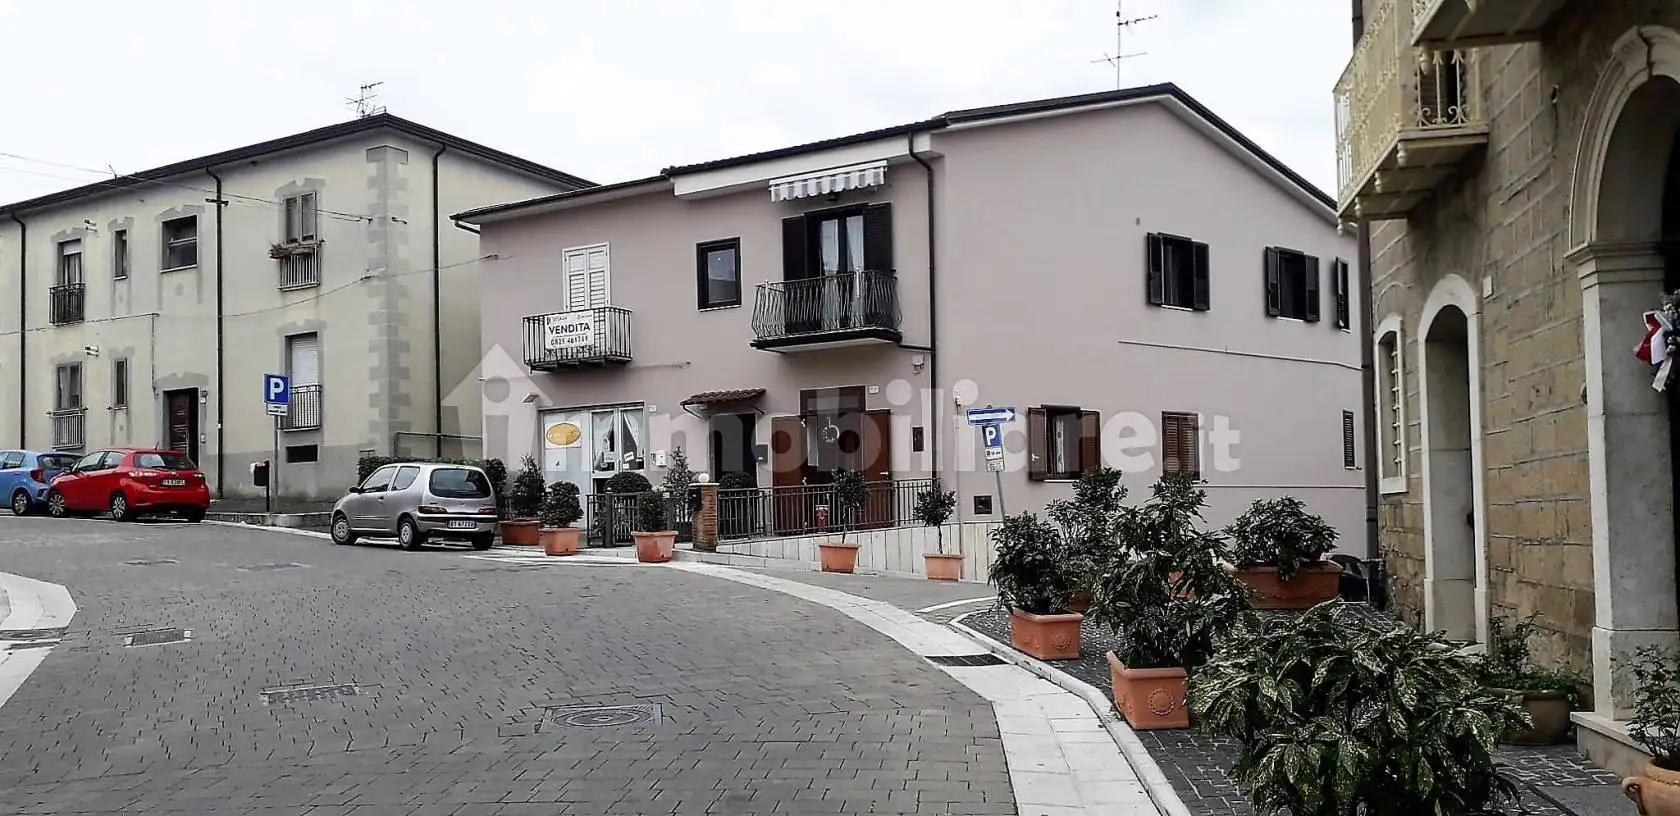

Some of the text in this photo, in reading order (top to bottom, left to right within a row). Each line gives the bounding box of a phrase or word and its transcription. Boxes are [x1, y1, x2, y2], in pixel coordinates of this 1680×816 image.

[549, 322, 591, 335] VENDITA
[270, 377, 284, 400] P
[985, 426, 997, 446] P
